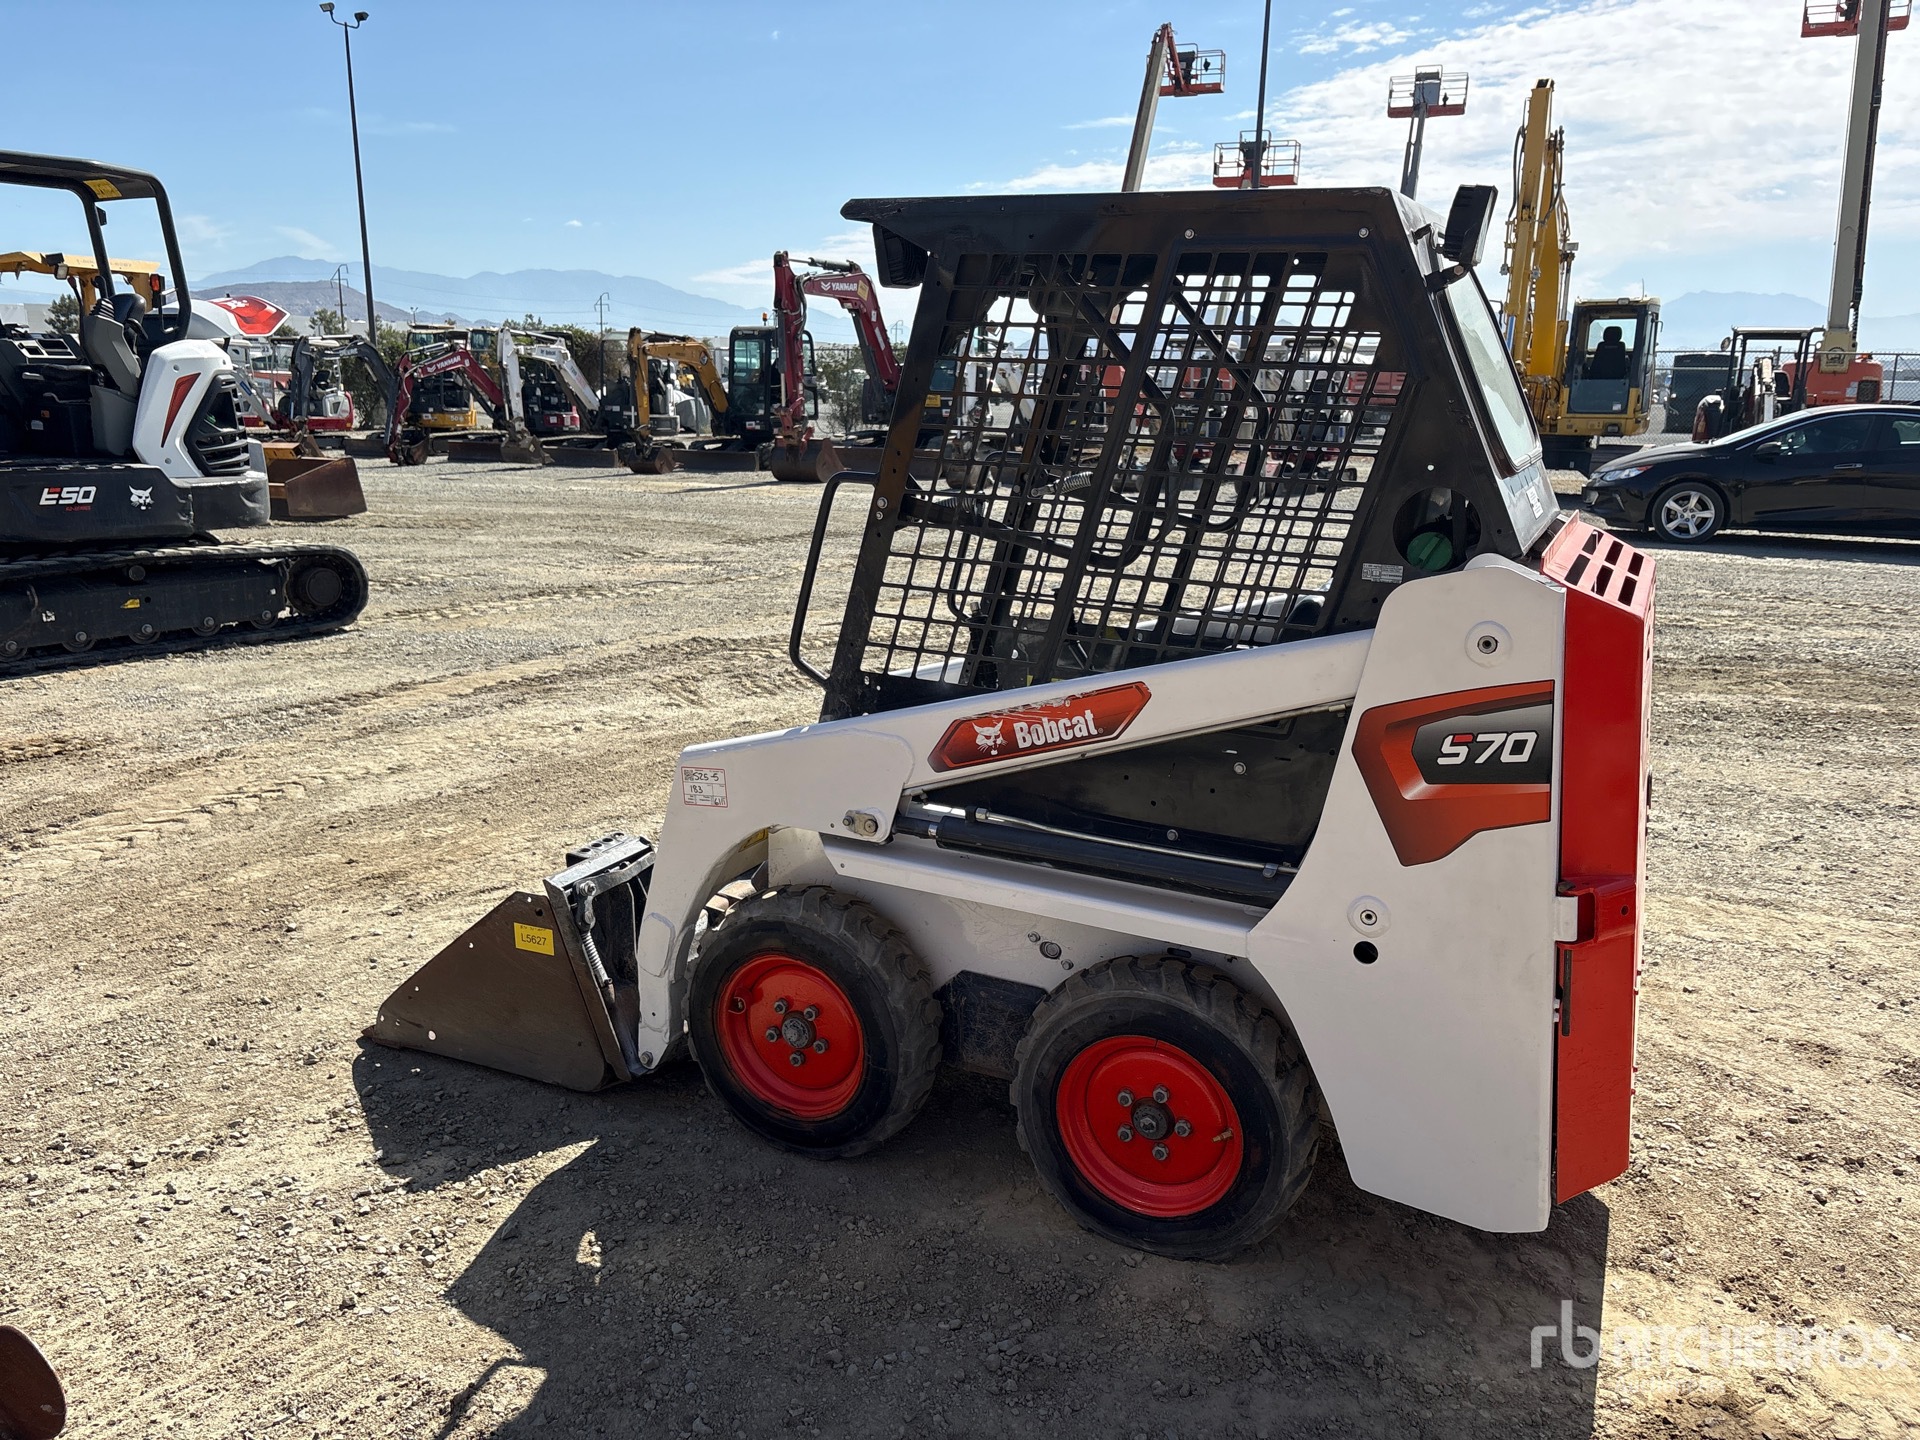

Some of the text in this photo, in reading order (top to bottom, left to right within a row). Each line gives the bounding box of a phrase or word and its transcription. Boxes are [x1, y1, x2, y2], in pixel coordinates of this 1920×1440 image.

[831, 282, 858, 291] YANMAR
[436, 355, 461, 369] YANMAR
[39, 485, 97, 505] E50
[1012, 709, 1098, 749] Bobcat
[1437, 731, 1538, 765] S70
[690, 784, 703, 794] 183
[521, 932, 547, 946] L5627
